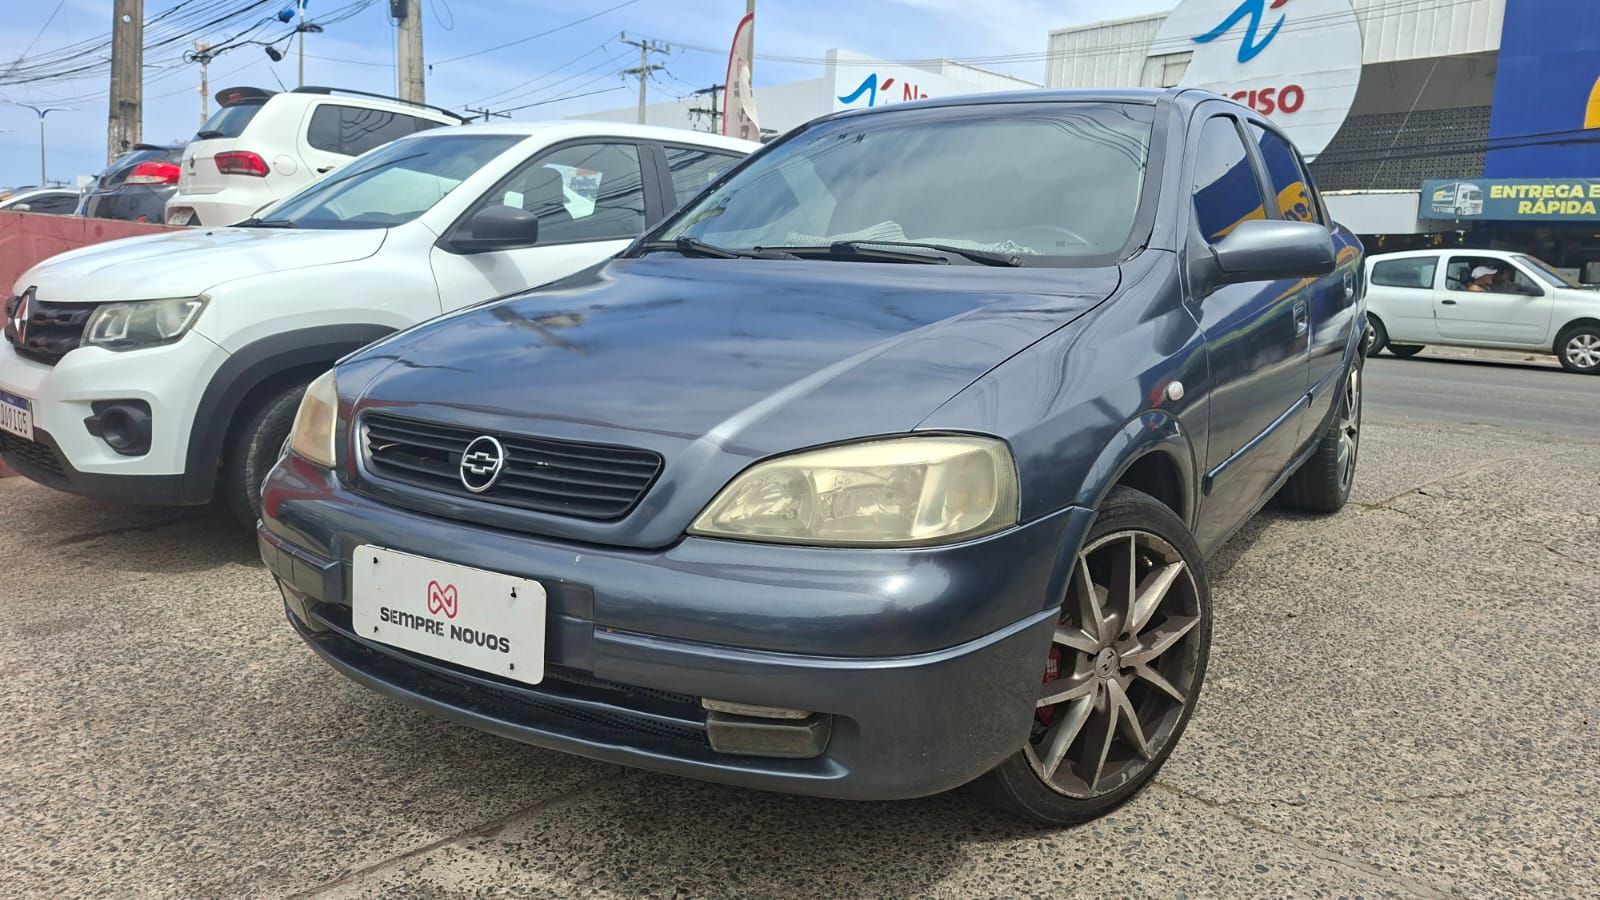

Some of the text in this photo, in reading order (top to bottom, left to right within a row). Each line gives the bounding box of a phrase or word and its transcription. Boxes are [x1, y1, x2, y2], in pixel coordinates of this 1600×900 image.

[1490, 184, 1584, 199] ENTREGA
[1518, 197, 1597, 215] RÁPIDA
[380, 606, 510, 653] SEMPRE NOVOS
